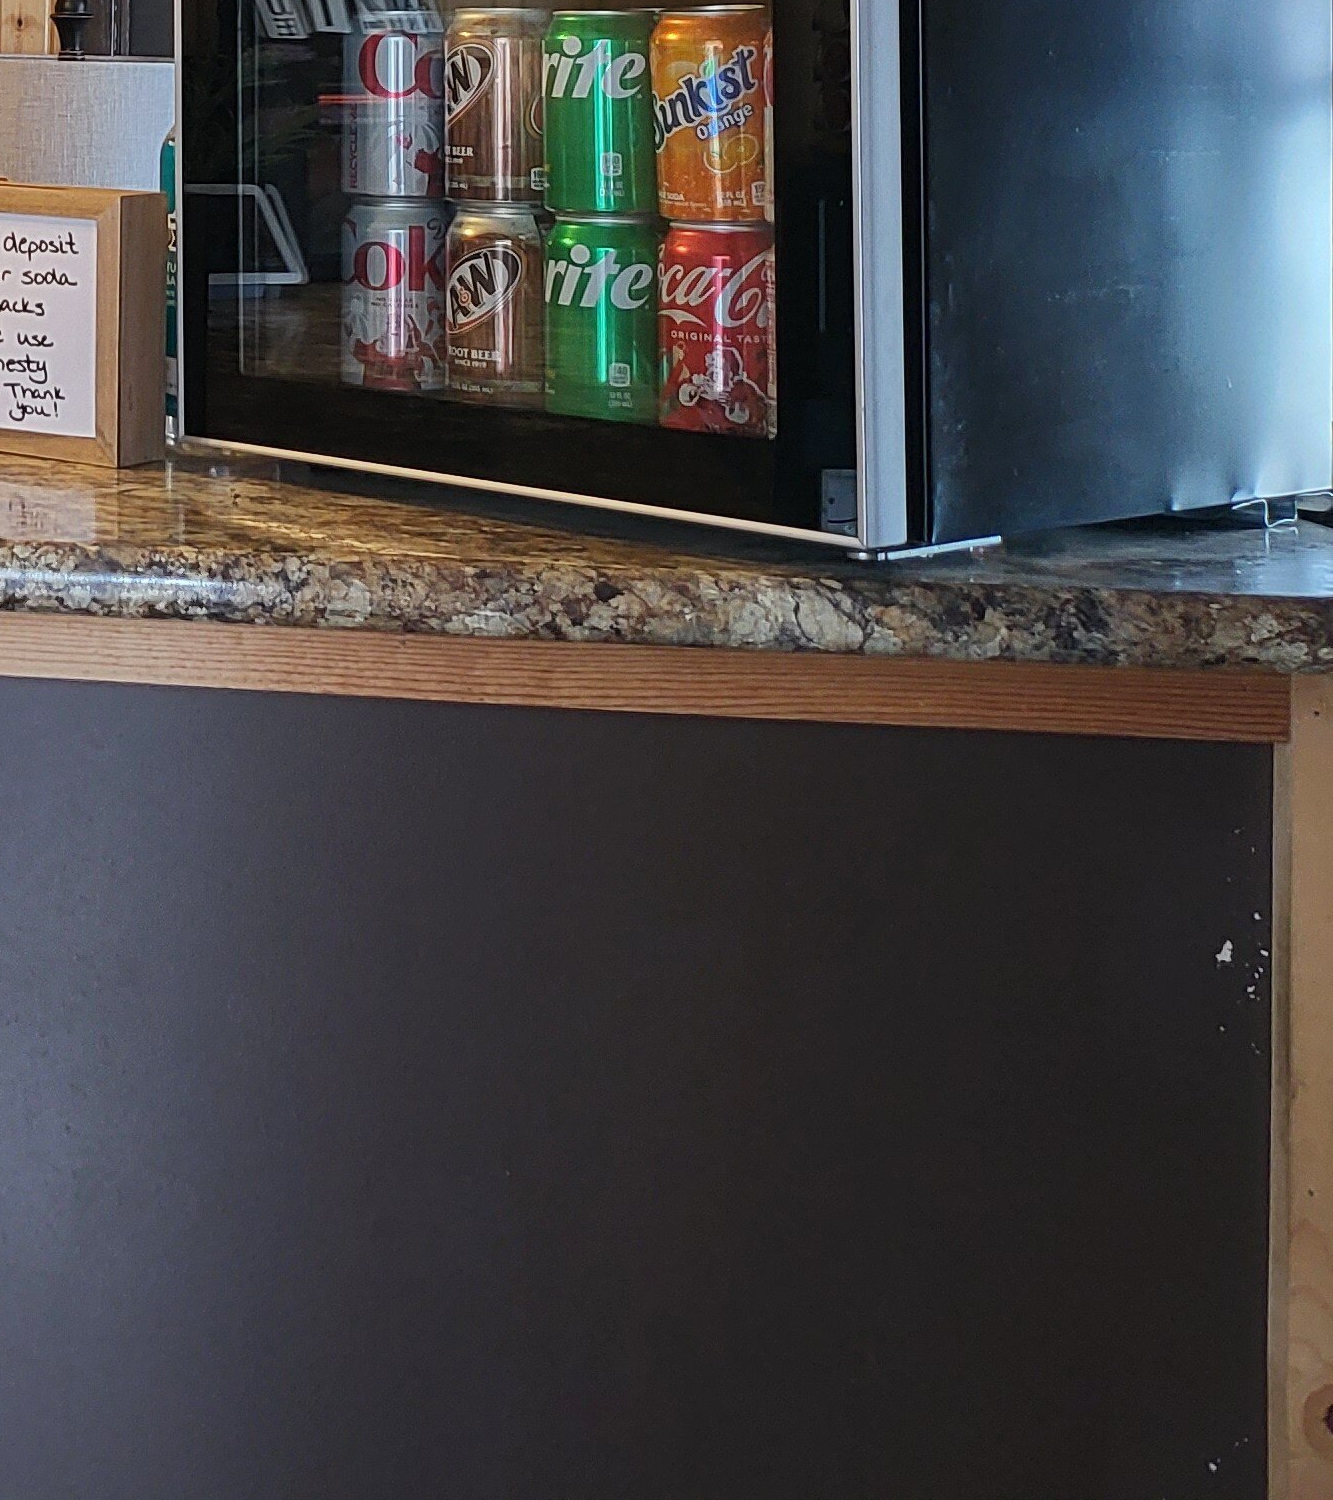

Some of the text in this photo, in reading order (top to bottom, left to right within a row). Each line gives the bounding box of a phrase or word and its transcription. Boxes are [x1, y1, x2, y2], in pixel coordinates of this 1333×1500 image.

[695, 103, 754, 140] Orange
[3, 232, 79, 262] deposit
[21, 268, 78, 286] soda
[545, 244, 654, 310] rite
[17, 332, 54, 348] use
[671, 329, 731, 343] ORIGINAL
[3, 382, 66, 401] Thank
[8, 401, 59, 422] you!
